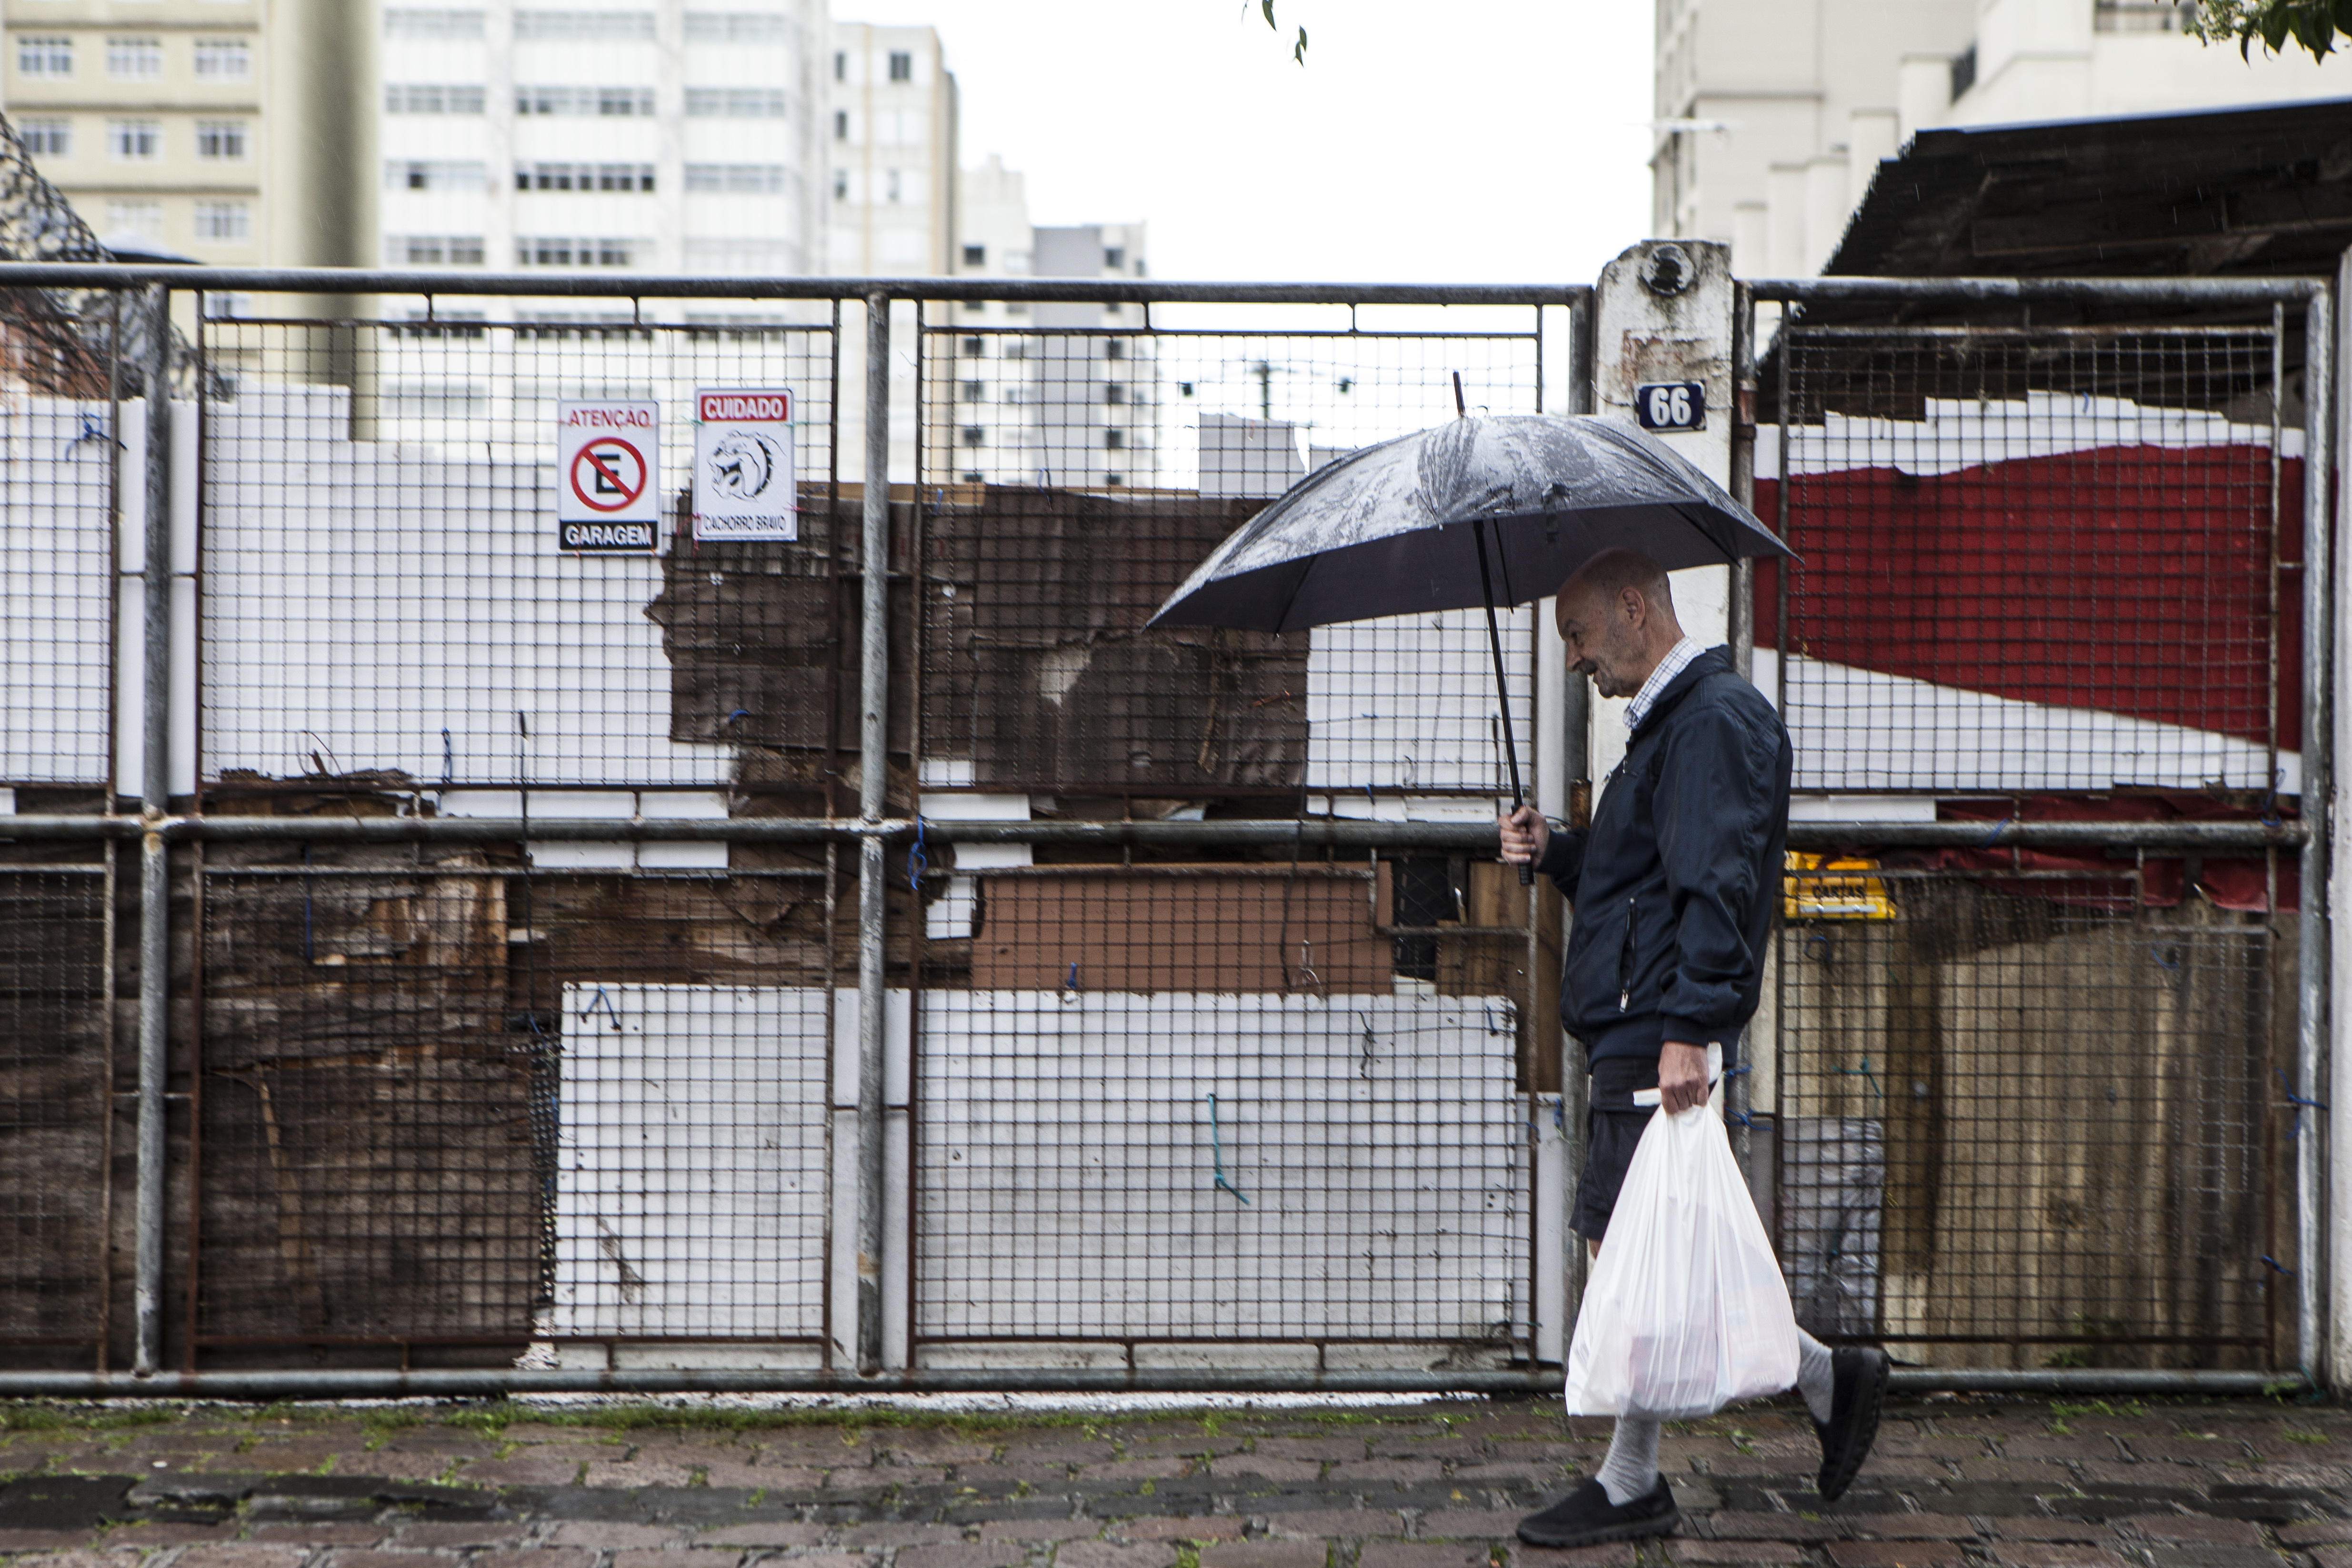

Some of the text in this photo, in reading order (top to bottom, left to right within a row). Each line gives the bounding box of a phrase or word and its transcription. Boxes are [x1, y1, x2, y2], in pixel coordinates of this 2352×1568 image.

[569, 406, 651, 430] ATENÇÃO
[704, 397, 784, 420] CUIDADO
[1649, 387, 1692, 427] 66
[595, 453, 621, 493] E
[703, 515, 786, 531] CACHORRO BRAVO
[565, 524, 652, 546] GARAGEM
